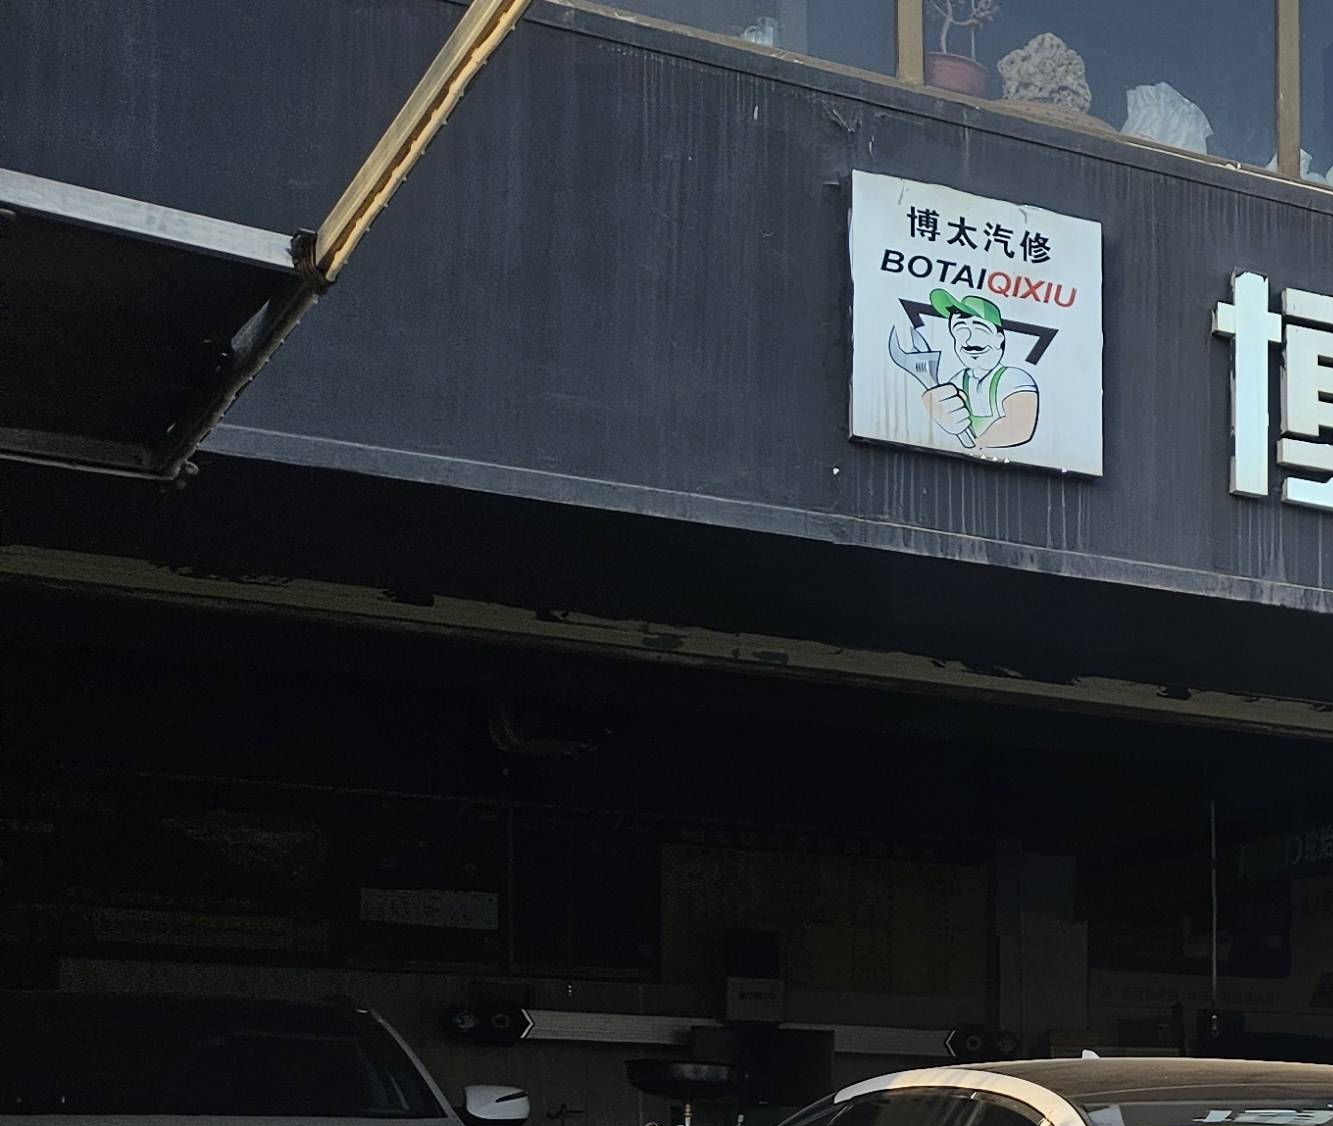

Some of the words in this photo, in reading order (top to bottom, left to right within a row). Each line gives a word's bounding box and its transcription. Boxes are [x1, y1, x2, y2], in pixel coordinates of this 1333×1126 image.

[907, 206, 1051, 264] 博太汽修
[880, 248, 1078, 308] BOTAIQIXIU
